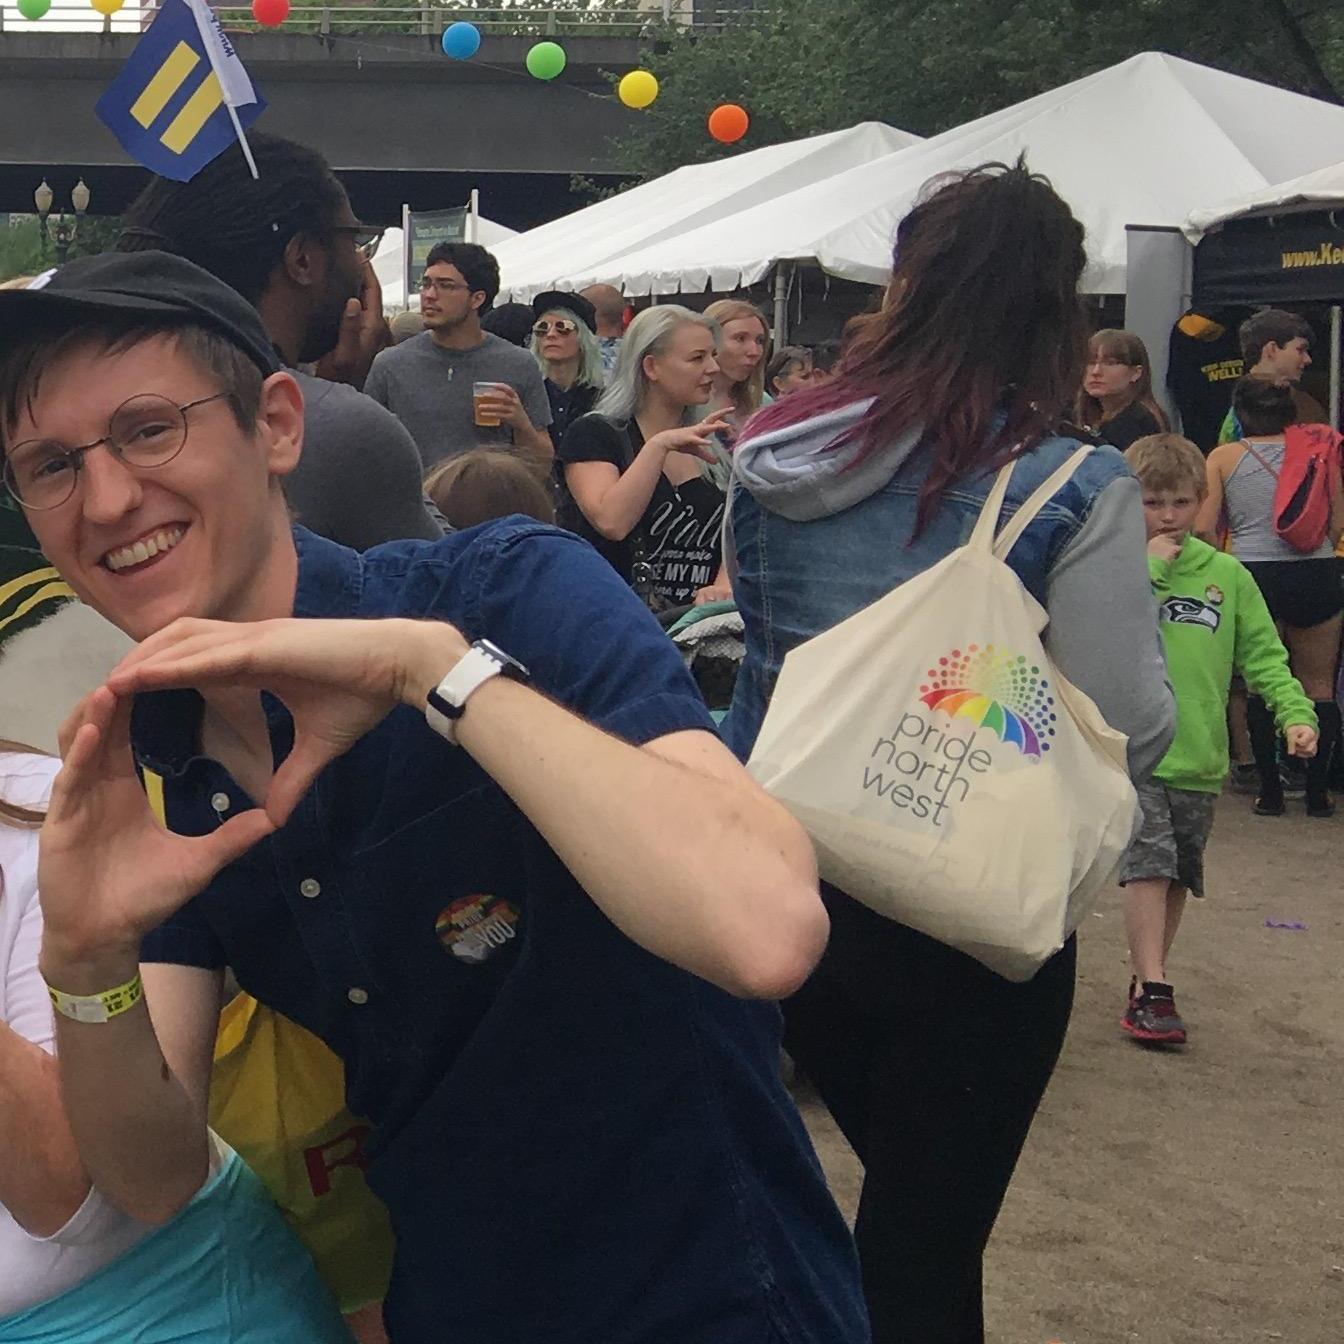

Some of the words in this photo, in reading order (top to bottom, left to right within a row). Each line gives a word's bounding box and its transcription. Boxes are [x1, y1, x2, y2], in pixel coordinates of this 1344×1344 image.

[1281, 242, 1344, 269] www.Ke
[665, 563, 690, 582] MY
[871, 737, 970, 803] north
[891, 712, 992, 774] pride
[862, 766, 949, 827] west
